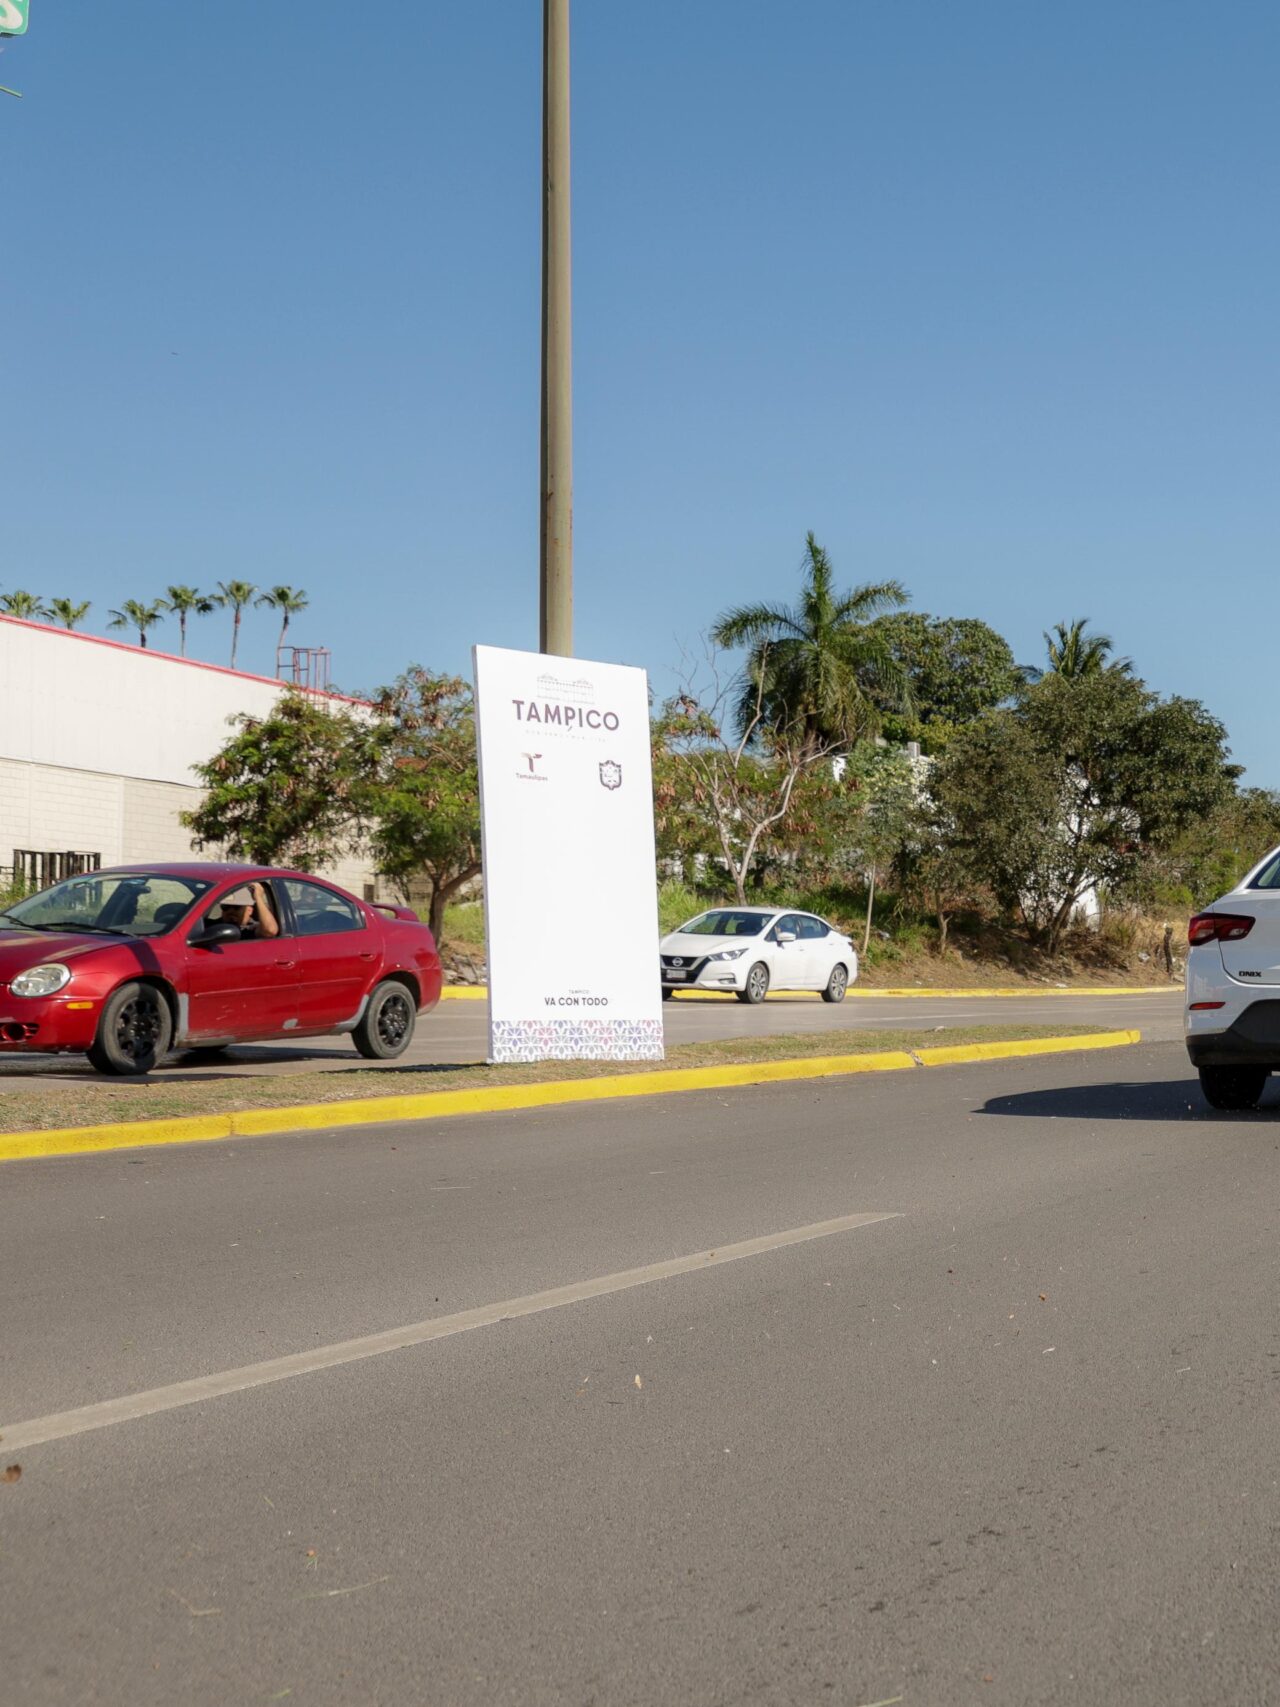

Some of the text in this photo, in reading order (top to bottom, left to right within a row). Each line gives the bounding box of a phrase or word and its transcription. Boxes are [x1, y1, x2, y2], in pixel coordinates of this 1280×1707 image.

[512, 699, 620, 731] TAMPICO
[544, 997, 609, 1006] VA CON TODO
